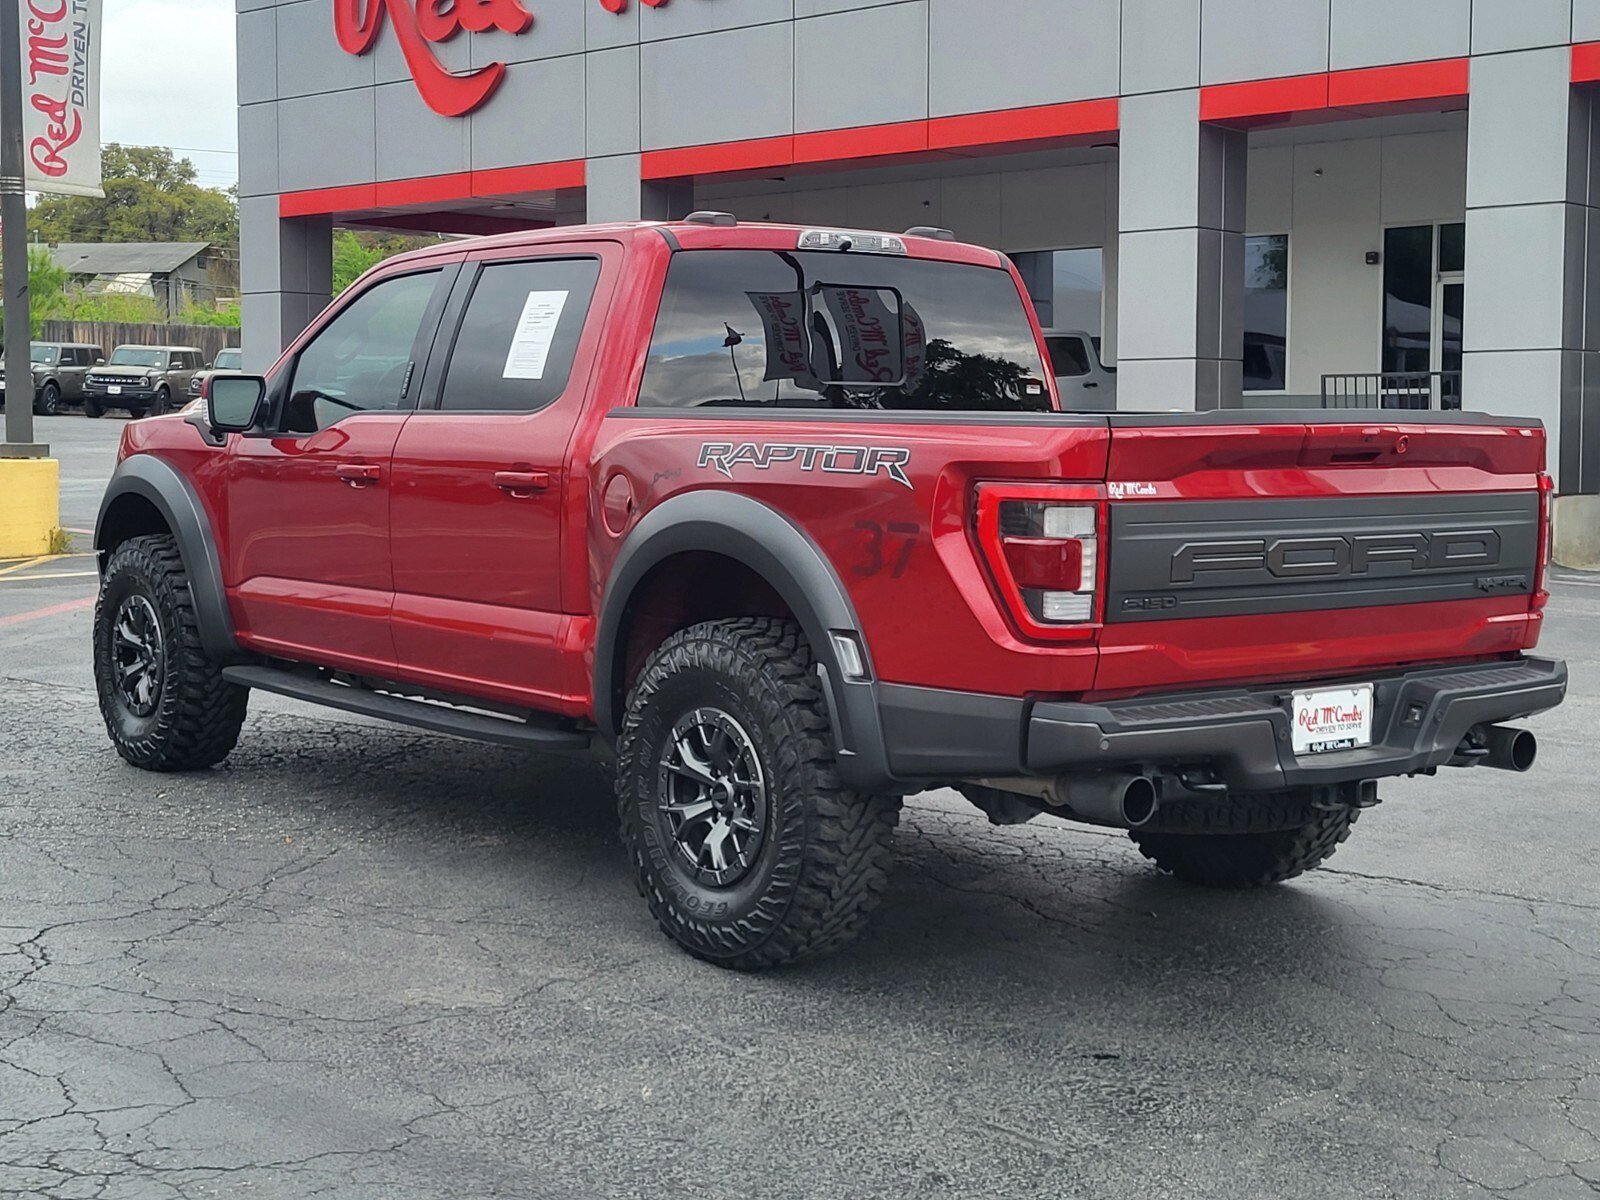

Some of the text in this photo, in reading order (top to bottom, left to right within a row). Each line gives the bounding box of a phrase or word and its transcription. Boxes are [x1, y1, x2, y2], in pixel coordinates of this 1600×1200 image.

[71, 0, 87, 107] DRIVEN T
[30, 93, 82, 177] Red
[696, 442, 915, 490] RAPTOR
[1109, 481, 1124, 499] Red
[852, 518, 921, 579] 37
[1170, 529, 1500, 584] FORD
[1299, 704, 1363, 732] Red McCombs
[1316, 722, 1362, 734] DRIVEN TO SERVE
